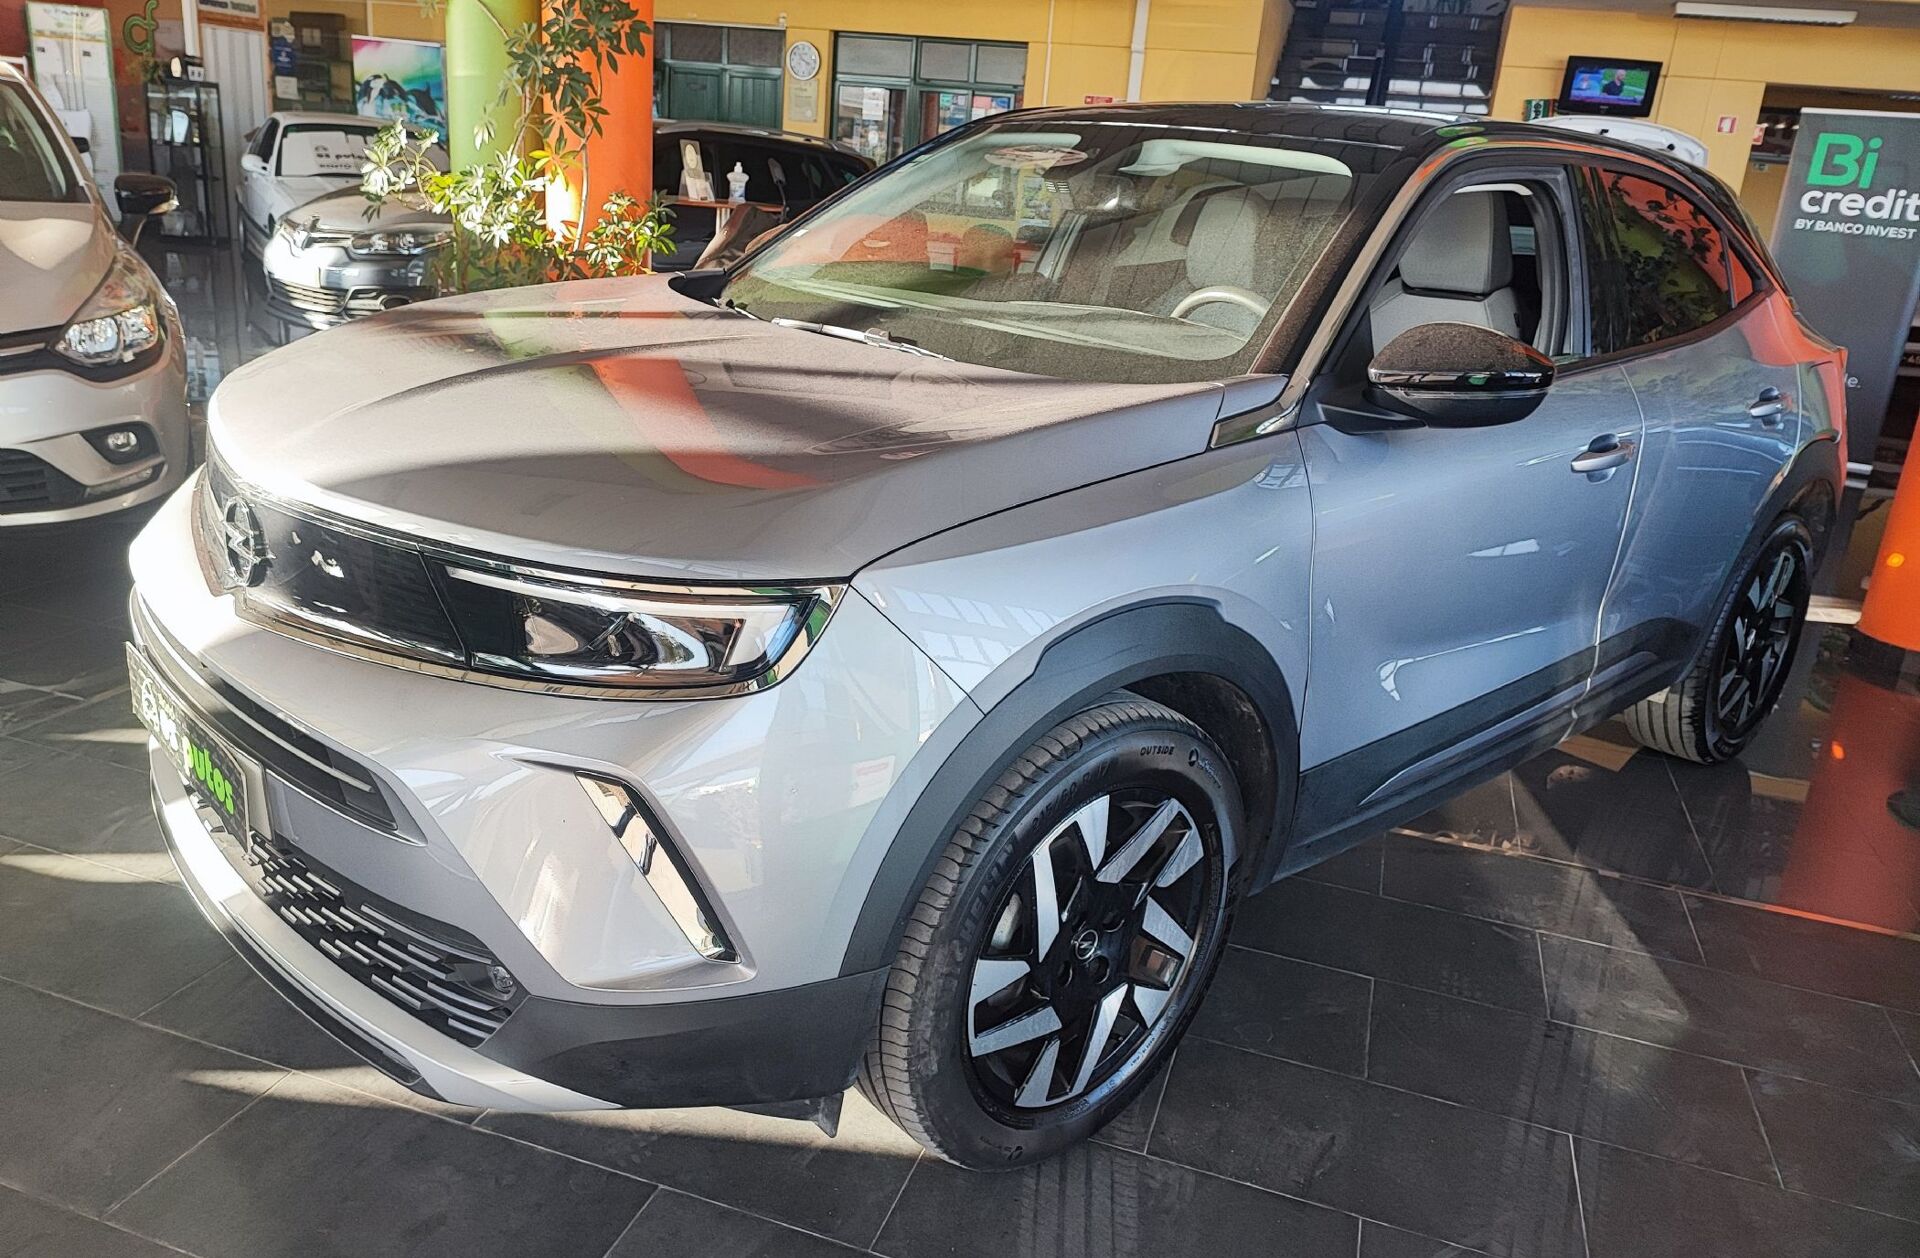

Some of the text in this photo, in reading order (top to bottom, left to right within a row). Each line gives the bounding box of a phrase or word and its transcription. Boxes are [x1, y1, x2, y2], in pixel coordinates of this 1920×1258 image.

[1807, 132, 1883, 189] Bi
[1801, 188, 1920, 222] credit
[1794, 218, 1917, 240] BY BANCO INVEST
[1140, 746, 1175, 756] OUTSIDE
